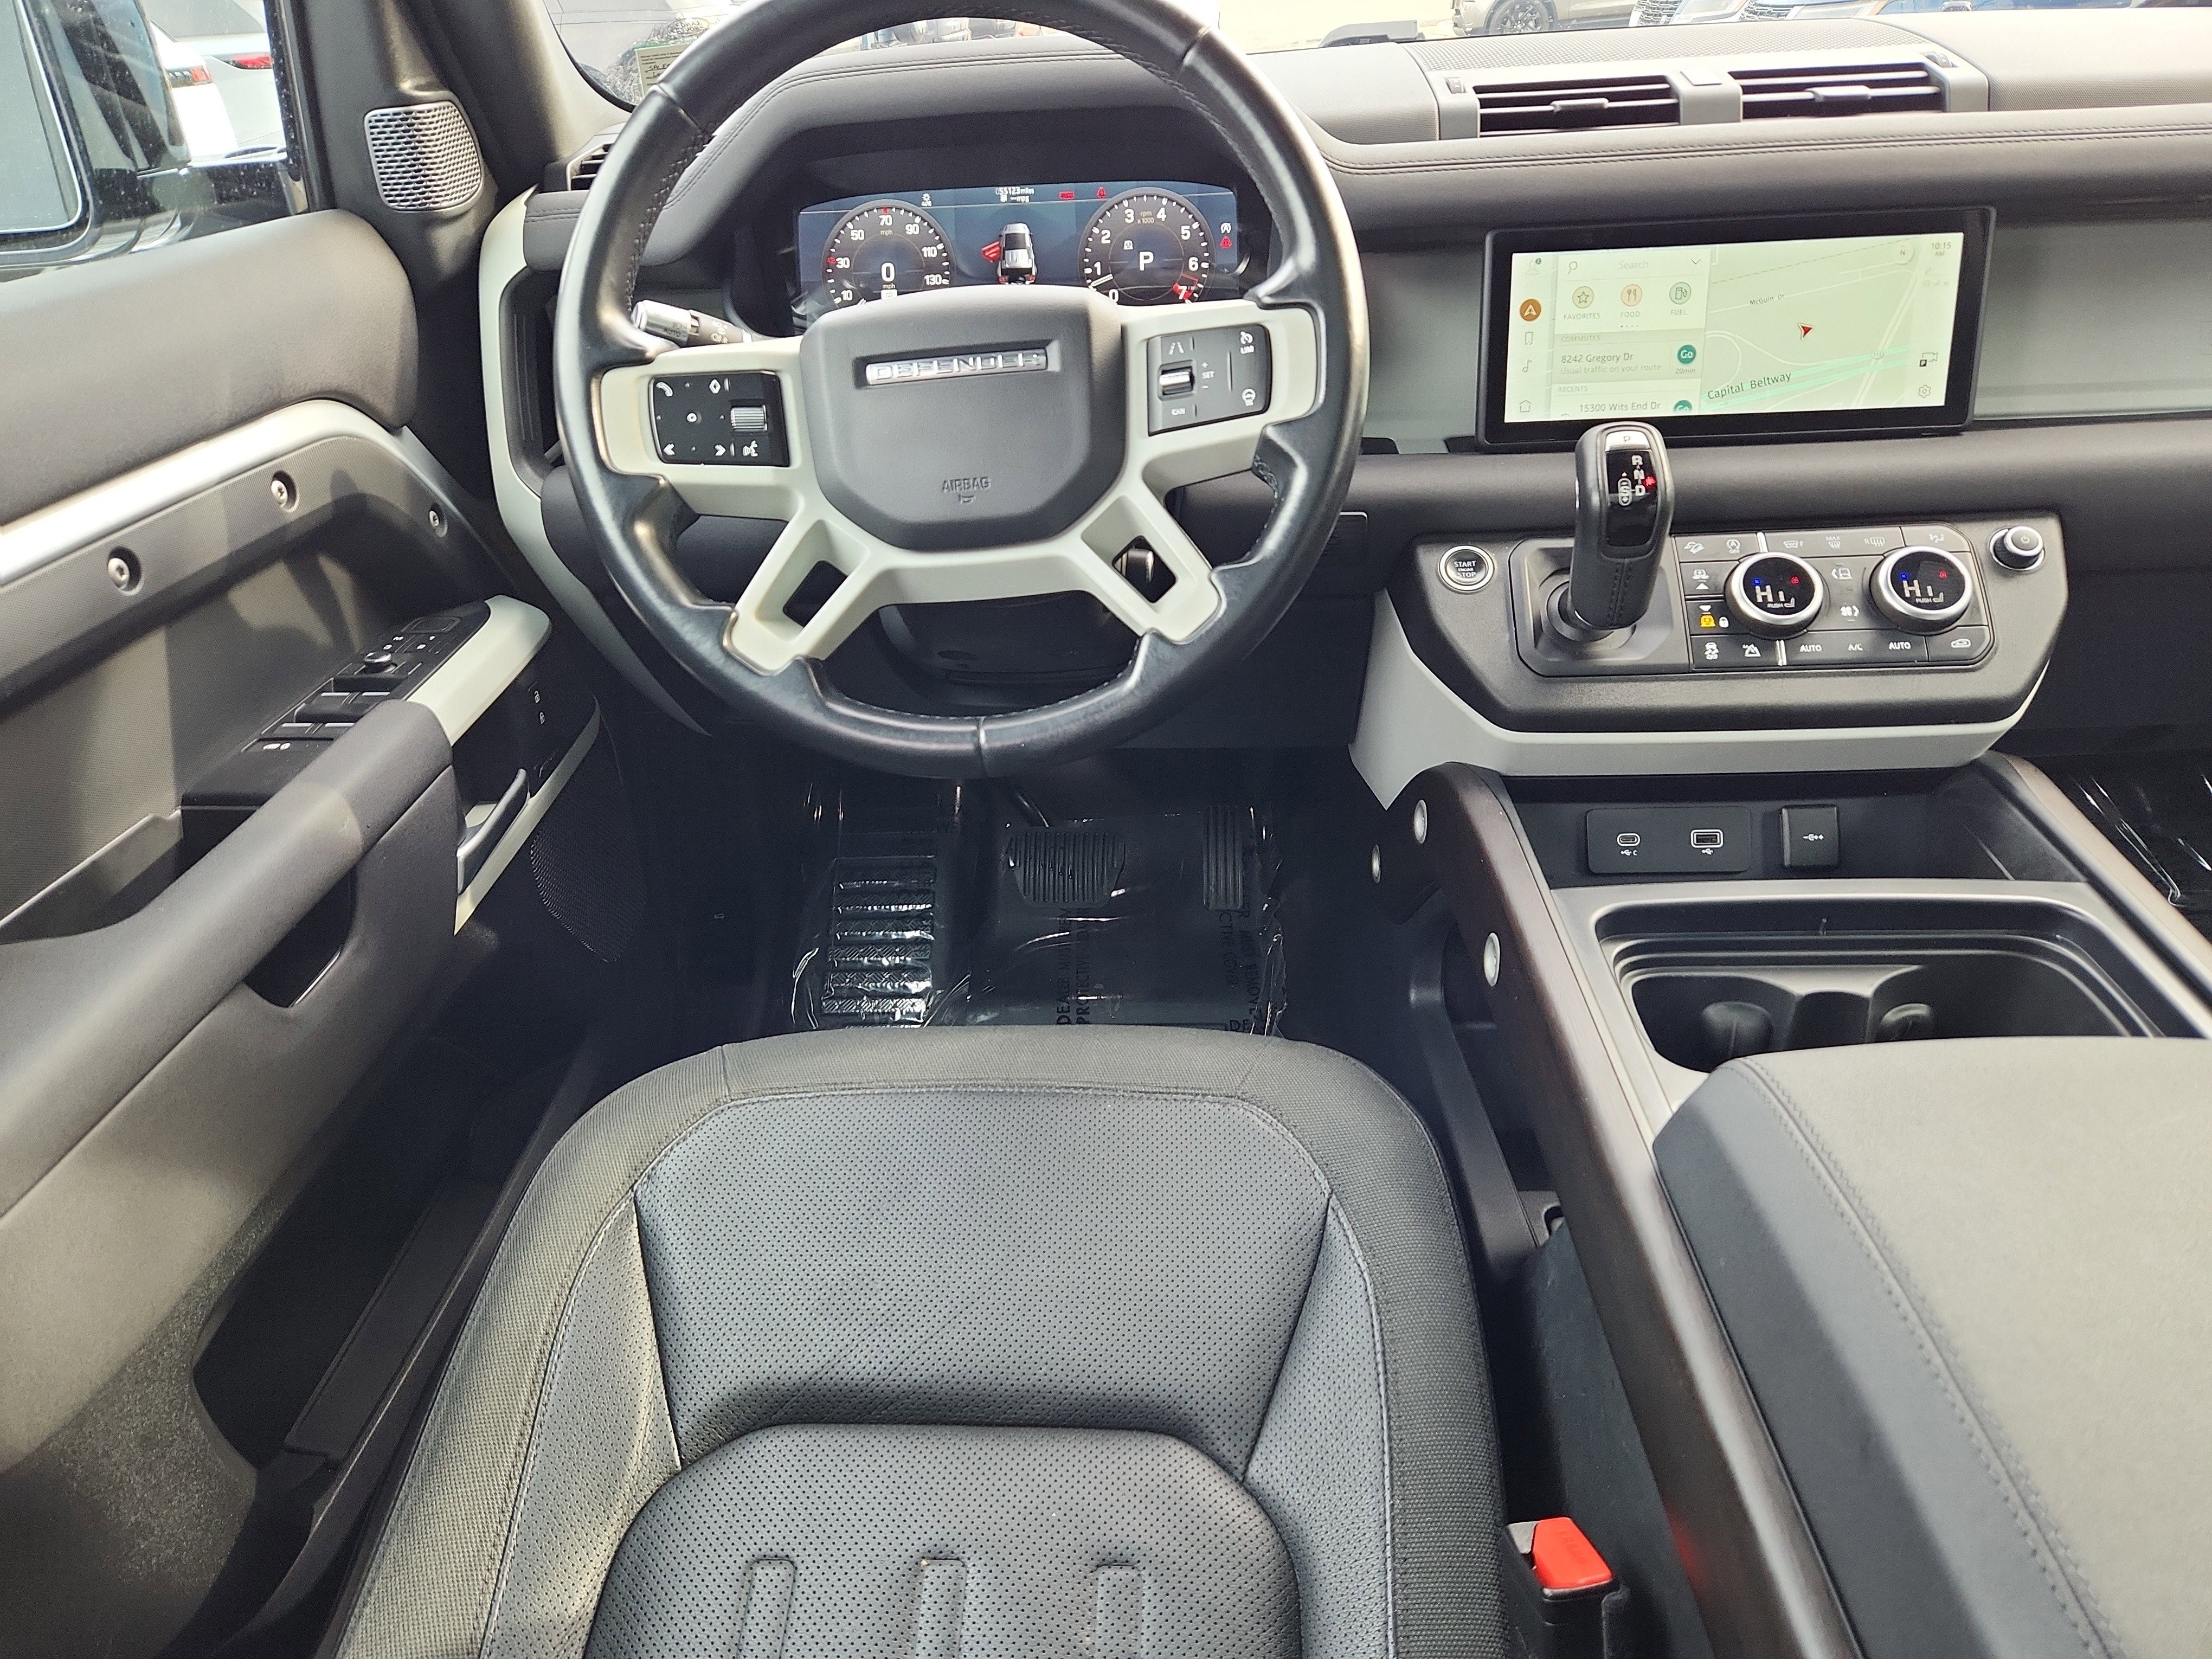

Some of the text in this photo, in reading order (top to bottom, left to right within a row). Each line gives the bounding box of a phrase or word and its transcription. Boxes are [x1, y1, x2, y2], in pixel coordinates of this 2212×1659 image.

[1124, 209, 1134, 223] 3
[1156, 207, 1167, 221] 4
[879, 215, 892, 226] 70
[851, 229, 865, 240] 50
[905, 223, 919, 235] 90
[1181, 225, 1191, 240] 5
[1101, 229, 1111, 244] 2
[922, 246, 937, 257] 110
[1932, 242, 1952, 250] 10:15
[835, 257, 850, 268] 30
[1139, 251, 1154, 271] P
[1188, 257, 1198, 271] 6
[1618, 260, 1649, 269] Search
[881, 262, 895, 281] 0
[1093, 261, 1101, 275] 1
[924, 274, 942, 285] 130
[841, 290, 853, 300] 10
[1109, 289, 1119, 303] 0
[1178, 286, 1187, 300] 7
[1561, 353, 1634, 364] 8242 Gregory Dr
[1680, 349, 1693, 359] Go
[1560, 366, 1581, 375] Usual
[1584, 365, 1607, 374] traffic
[1707, 372, 1791, 400] Capital Beltway
[1580, 401, 1661, 413] 15300 Wits End Dr
[1631, 455, 1643, 465] R
[1634, 469, 1645, 480] N
[942, 476, 991, 492] AIRBAG
[1635, 485, 1646, 496] D
[1799, 644, 1822, 652] AUTO
[1888, 641, 1911, 650] AUTO
